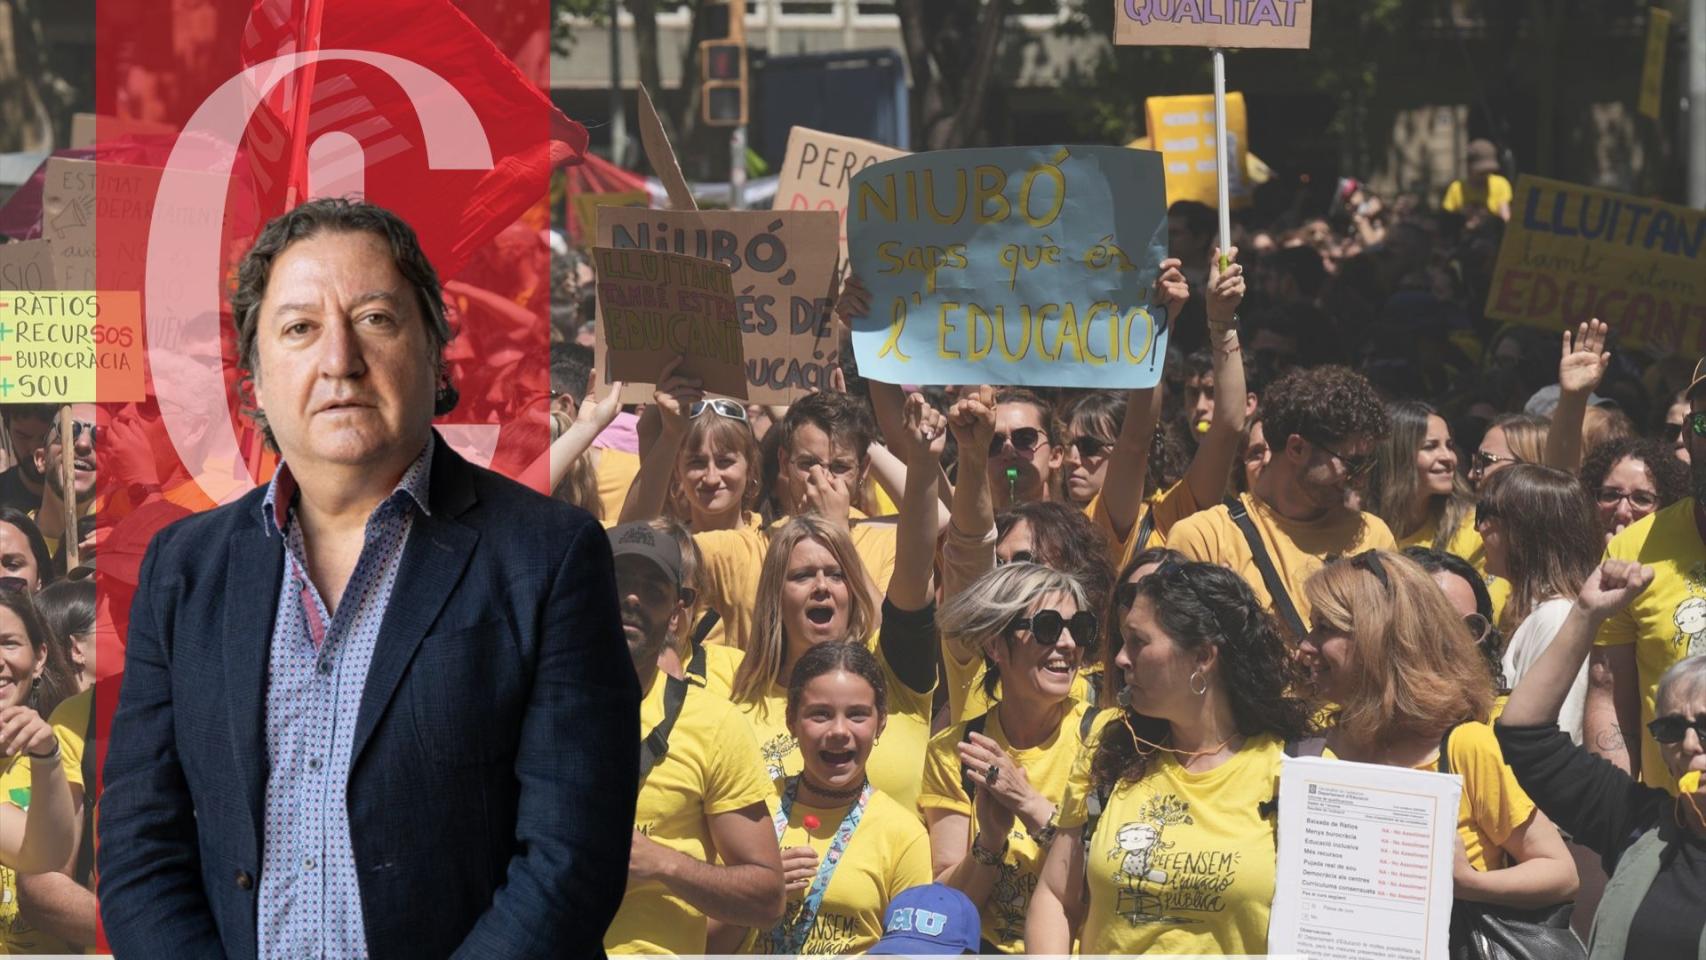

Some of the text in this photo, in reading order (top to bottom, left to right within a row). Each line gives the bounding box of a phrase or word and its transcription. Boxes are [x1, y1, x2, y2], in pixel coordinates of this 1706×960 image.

[1122, 0, 1303, 27] QUALITAT
[857, 147, 1071, 228] NIUBÓ
[1000, 234, 1061, 292] què
[600, 281, 669, 310] TAMBÉ
[790, 296, 833, 338] DE
[16, 321, 133, 348] RECURSOS
[606, 307, 743, 366] EDUCANT
[16, 346, 131, 371] BUROCRÀCIA
[18, 375, 68, 397] SOU
